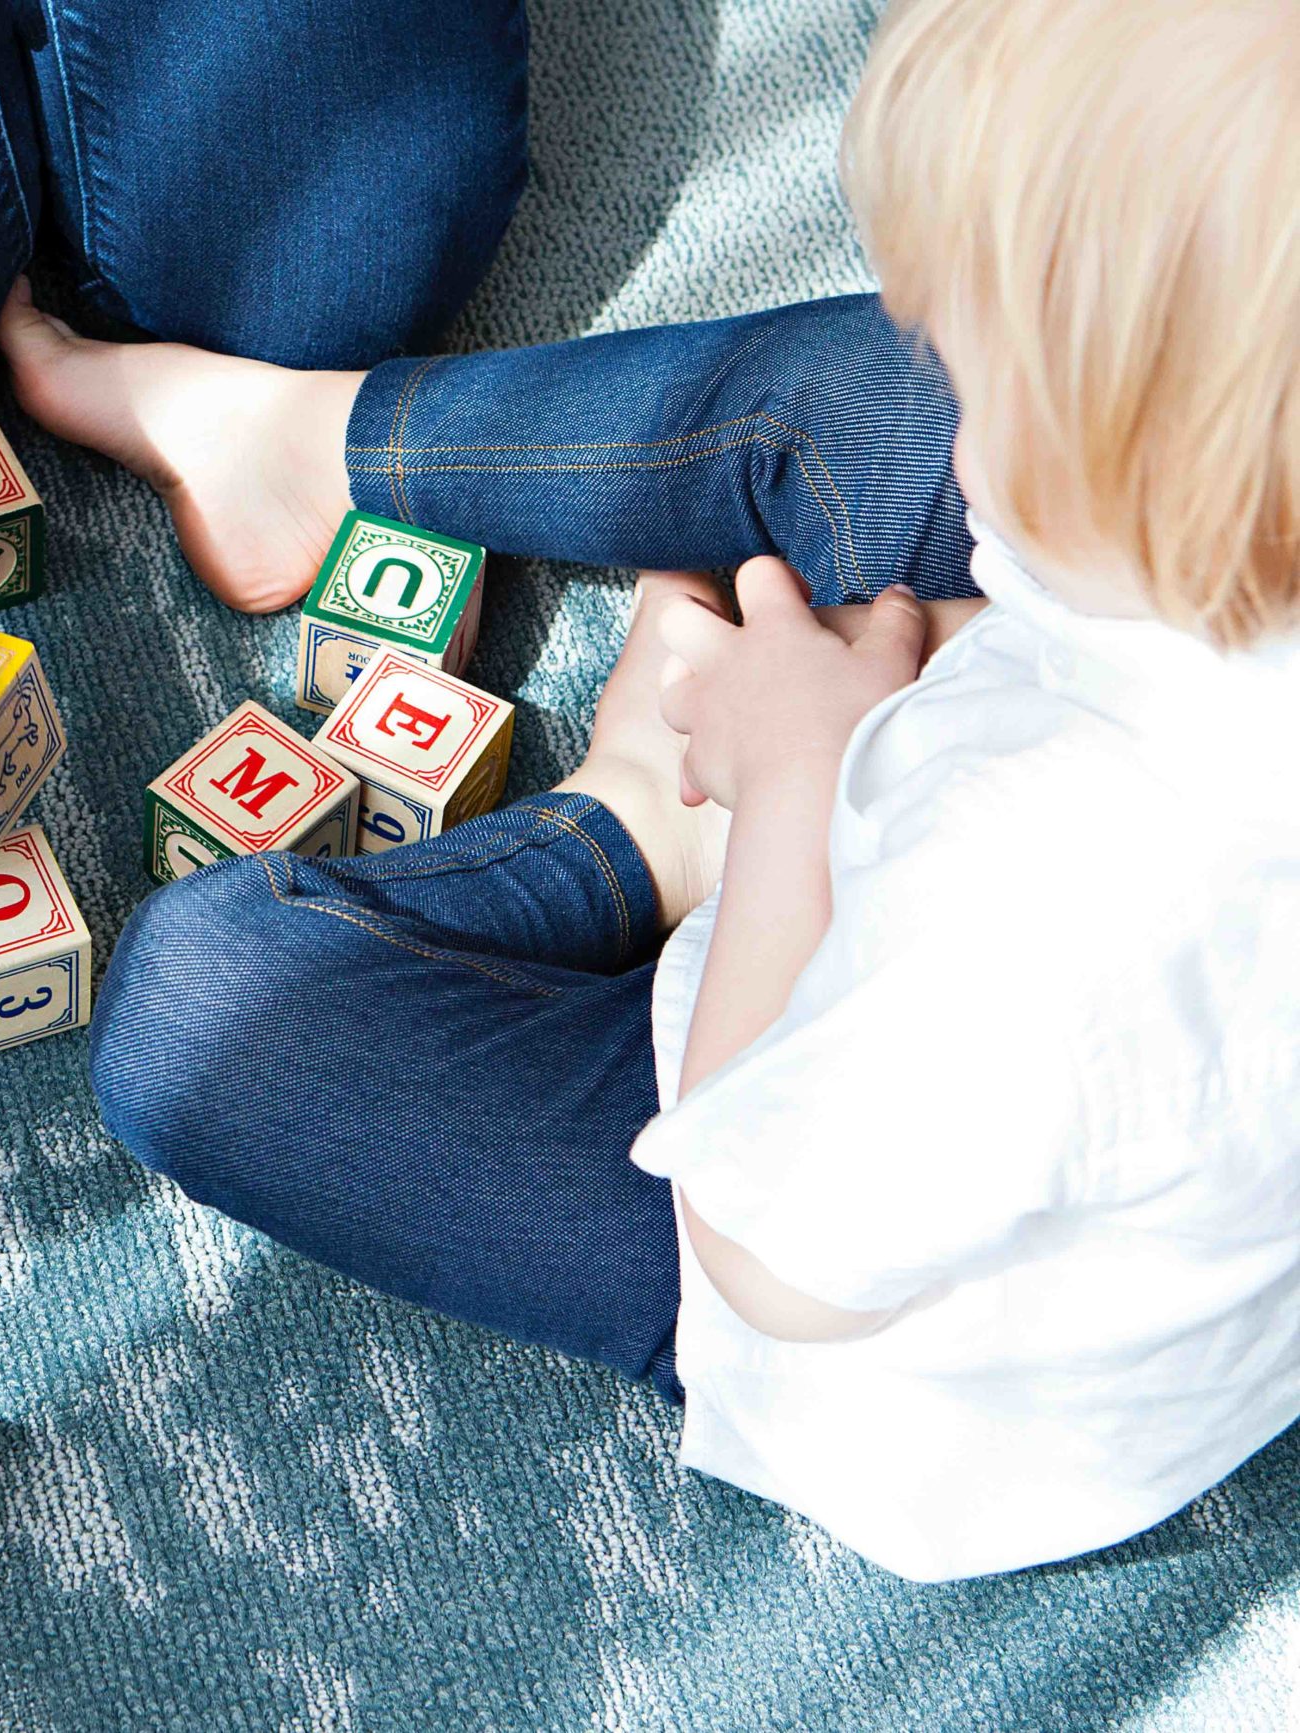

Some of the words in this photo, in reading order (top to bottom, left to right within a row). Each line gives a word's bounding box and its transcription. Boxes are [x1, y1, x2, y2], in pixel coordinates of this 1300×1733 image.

[362, 557, 423, 609] U
[347, 651, 371, 665] OUR
[375, 692, 452, 751] E
[16, 763, 31, 788] DOG
[209, 746, 299, 820] M
